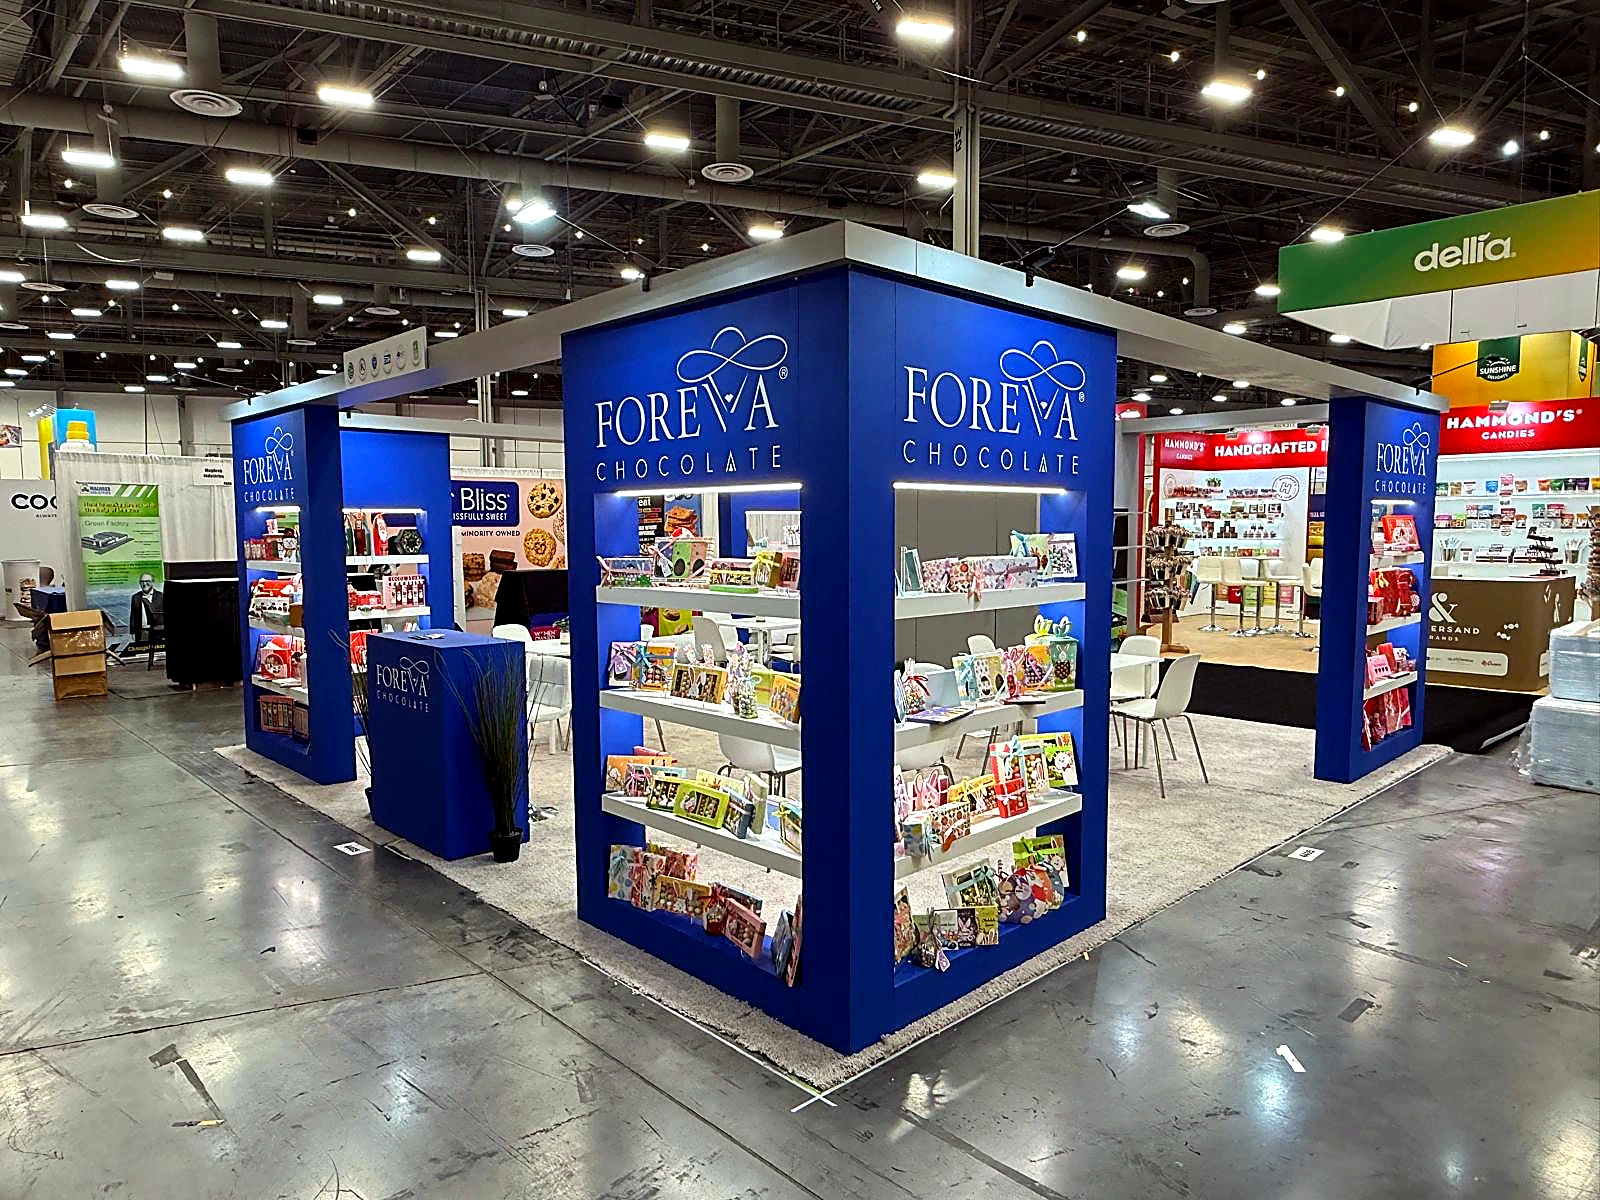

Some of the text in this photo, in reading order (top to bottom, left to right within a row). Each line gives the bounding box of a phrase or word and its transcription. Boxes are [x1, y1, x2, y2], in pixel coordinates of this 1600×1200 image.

[1479, 365, 1517, 375] SUNSHINE
[1446, 408, 1576, 430] HAMMOND'S
[1481, 428, 1536, 440] CANDIES
[903, 439, 1080, 475] CHOCOLATE
[1214, 440, 1318, 458] HANDCRAFTED
[596, 445, 782, 482] CHOCOLATE
[244, 487, 295, 503] CHOCOLATE
[1375, 479, 1427, 494] CHOCOLATE
[460, 487, 508, 511] Bliss
[485, 512, 507, 521] SWEET
[1430, 625, 1480, 635] ERSAND
[376, 689, 430, 713] CHOCOLATE
